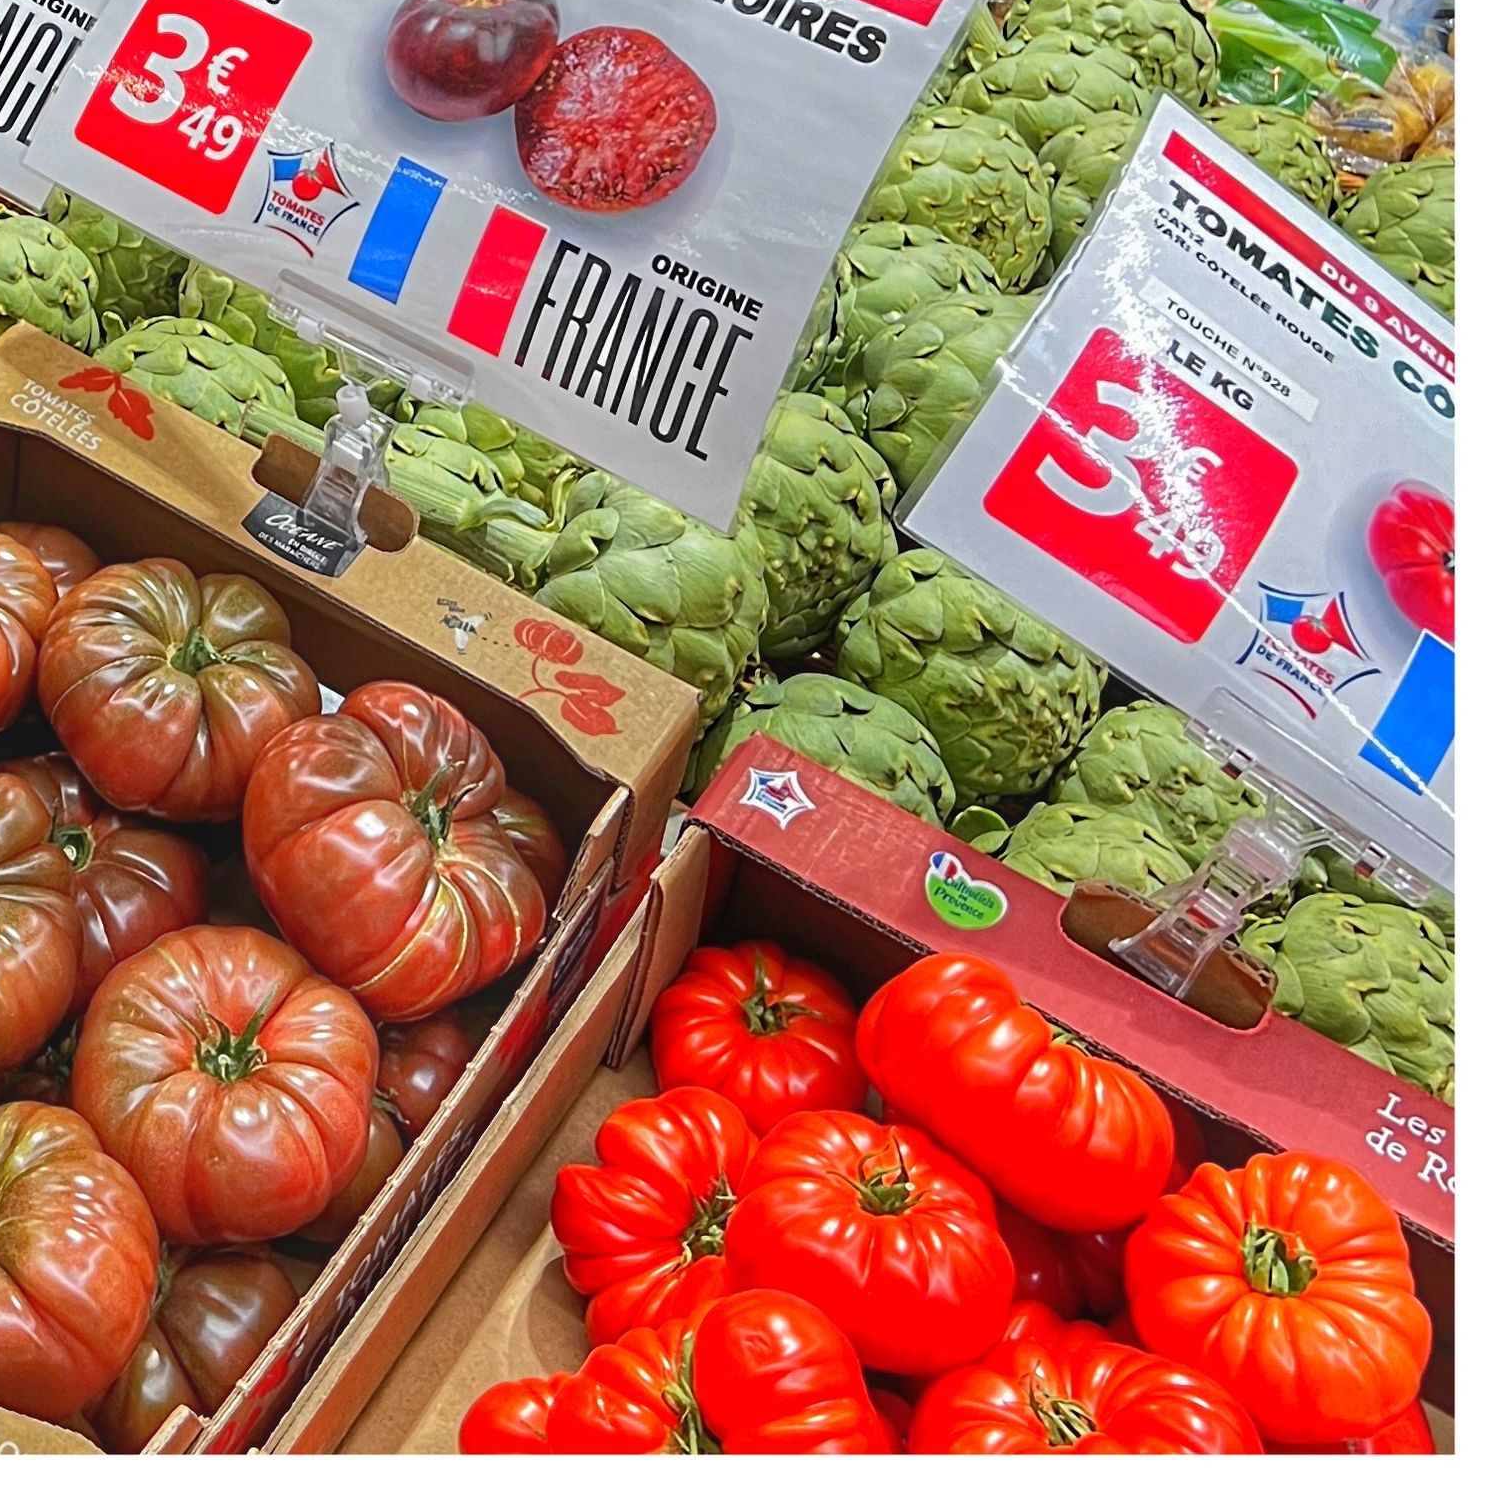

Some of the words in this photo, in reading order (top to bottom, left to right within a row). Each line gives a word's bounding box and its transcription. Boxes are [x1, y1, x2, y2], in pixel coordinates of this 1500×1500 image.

[110, 13, 210, 126] 3
[177, 105, 243, 161] 49
[266, 201, 281, 216] DE
[281, 208, 321, 237] FRANCE
[270, 189, 326, 227] TOMATES
[651, 254, 764, 322] ORIGINE
[1168, 179, 1380, 360] TOMATES
[1320, 260, 1358, 296] DU
[1361, 292, 1378, 315] 9
[514, 238, 753, 461] FRANCE
[1168, 297, 1240, 360] TOUCHE
[1242, 356, 1291, 398] N°928
[1276, 312, 1336, 364] ROUGE
[1166, 339, 1207, 377] LE
[1210, 371, 1254, 410] KG
[8, 392, 103, 453] CÔTELÉES
[22, 378, 96, 426] TOMATES
[265, 514, 344, 551] OCEANE
[934, 887, 984, 920] Provence
[1365, 1126, 1407, 1163] de
[1376, 1092, 1447, 1145] Les
